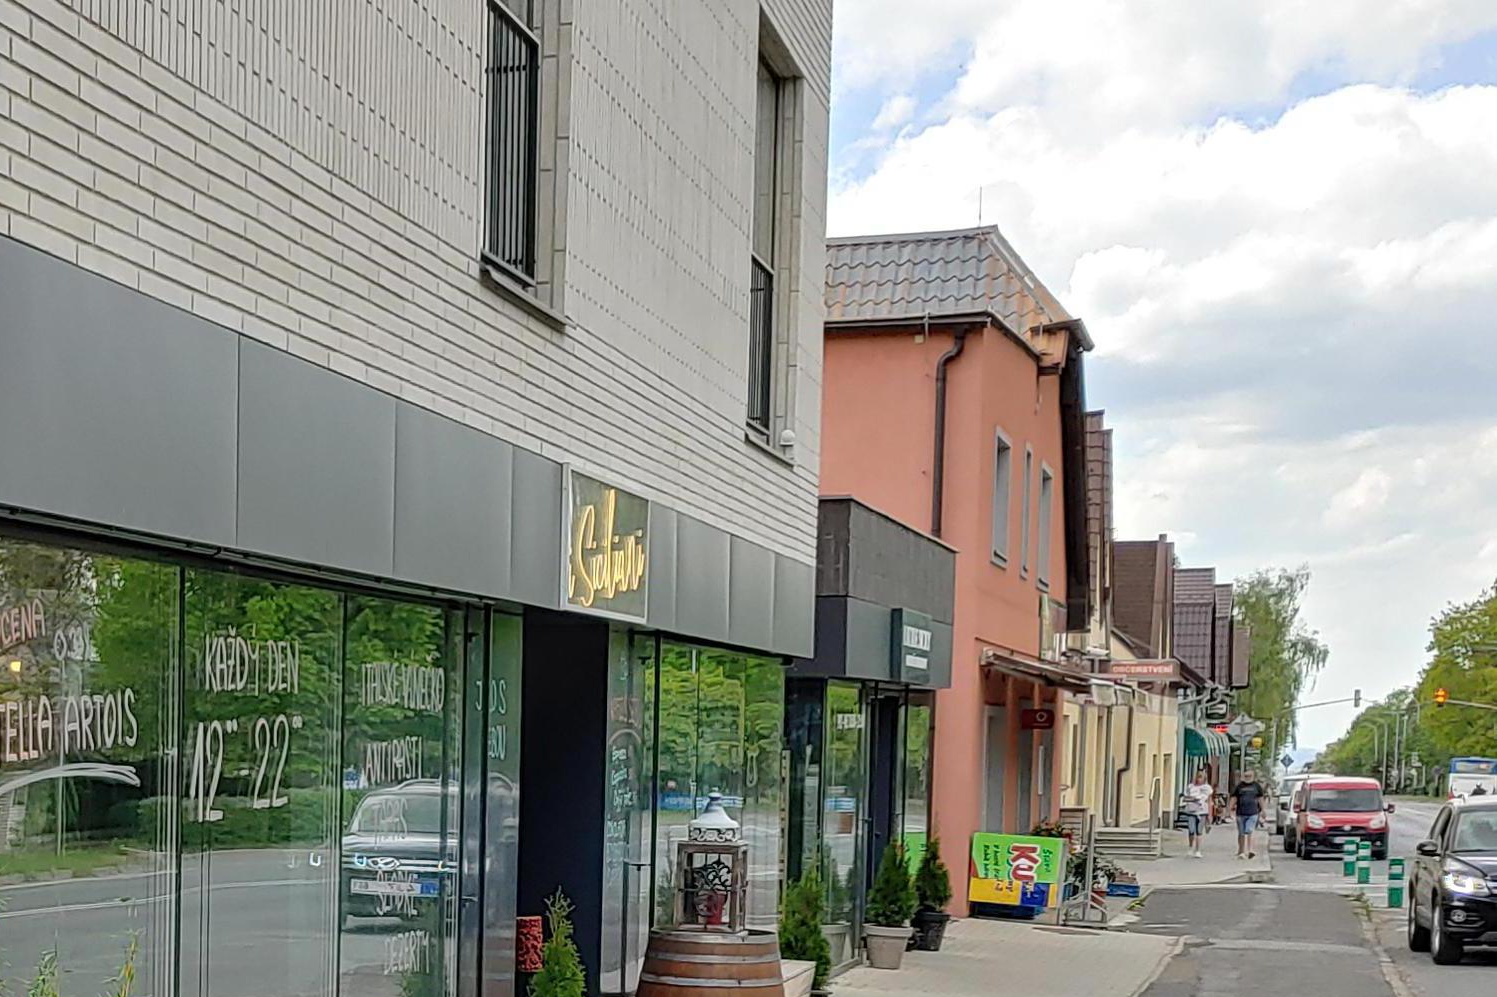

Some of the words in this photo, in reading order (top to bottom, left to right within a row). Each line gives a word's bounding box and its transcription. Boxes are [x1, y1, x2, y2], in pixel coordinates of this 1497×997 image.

[205, 624, 259, 696] KAŽDÝ
[268, 639, 298, 694] DEN
[64, 687, 138, 754] ARTOIS
[365, 736, 422, 785] ANTIPASTI
[384, 928, 430, 975] DEZERTY
